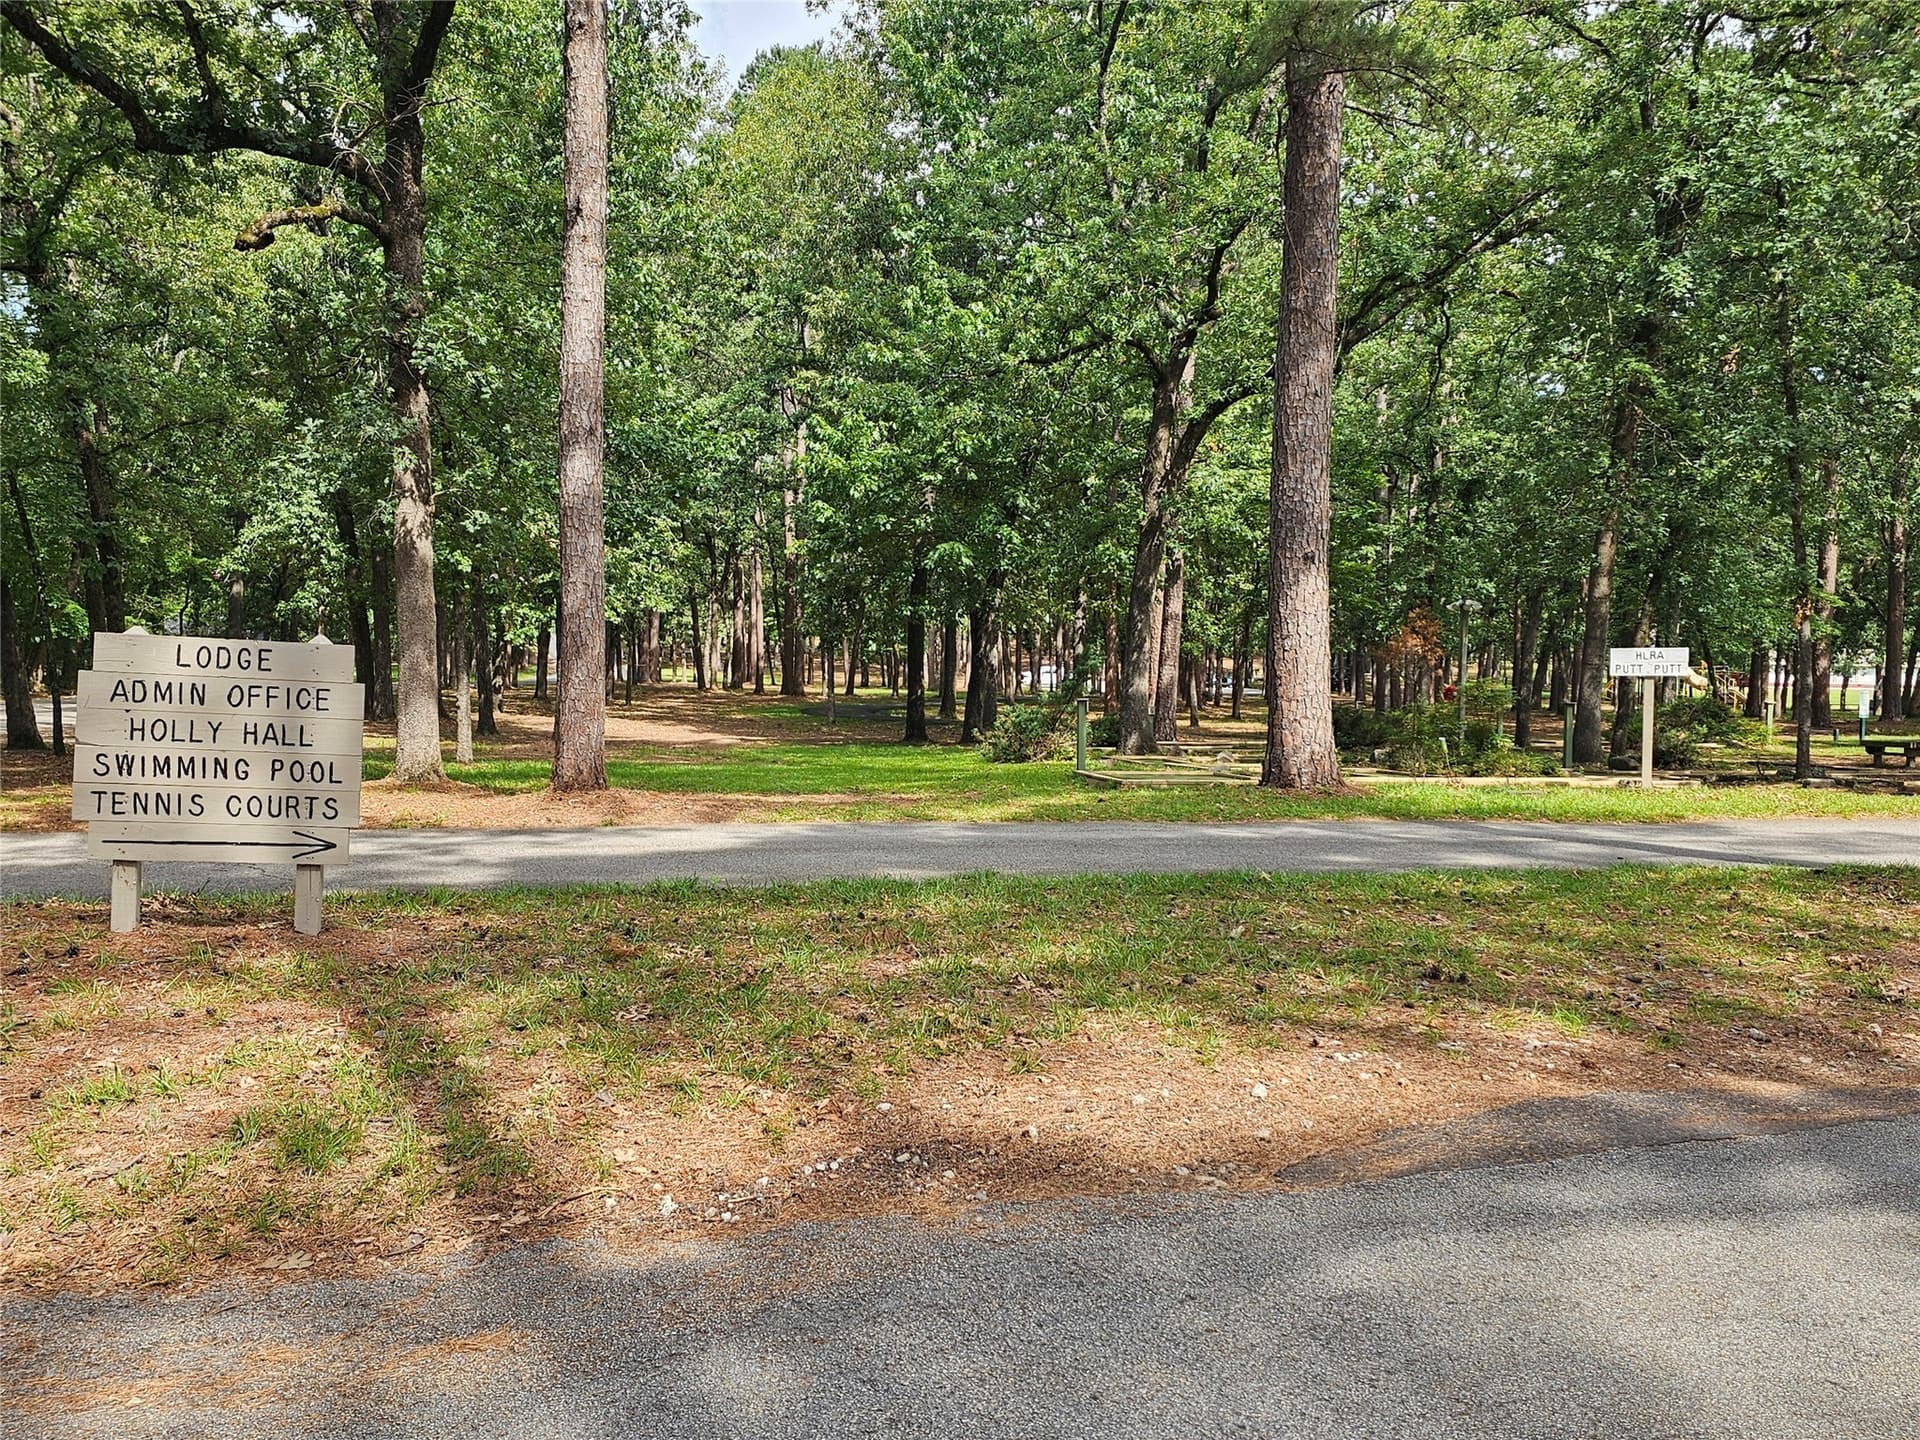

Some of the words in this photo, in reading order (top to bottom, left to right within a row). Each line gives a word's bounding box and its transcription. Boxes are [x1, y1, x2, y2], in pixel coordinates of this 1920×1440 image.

[177, 644, 273, 672] LODGE
[1615, 664, 1644, 674] PUTT
[1654, 664, 1682, 674] PUTT
[1635, 651, 1665, 660] HLRA
[110, 679, 206, 706] ADMIN
[227, 684, 331, 711] OFFICE
[129, 717, 223, 744] HOLLY
[243, 722, 313, 747] HALL
[93, 753, 250, 781] SWIMMING
[270, 759, 343, 784] POOL
[90, 790, 205, 817] TENNIS
[226, 795, 339, 821] COURTS
